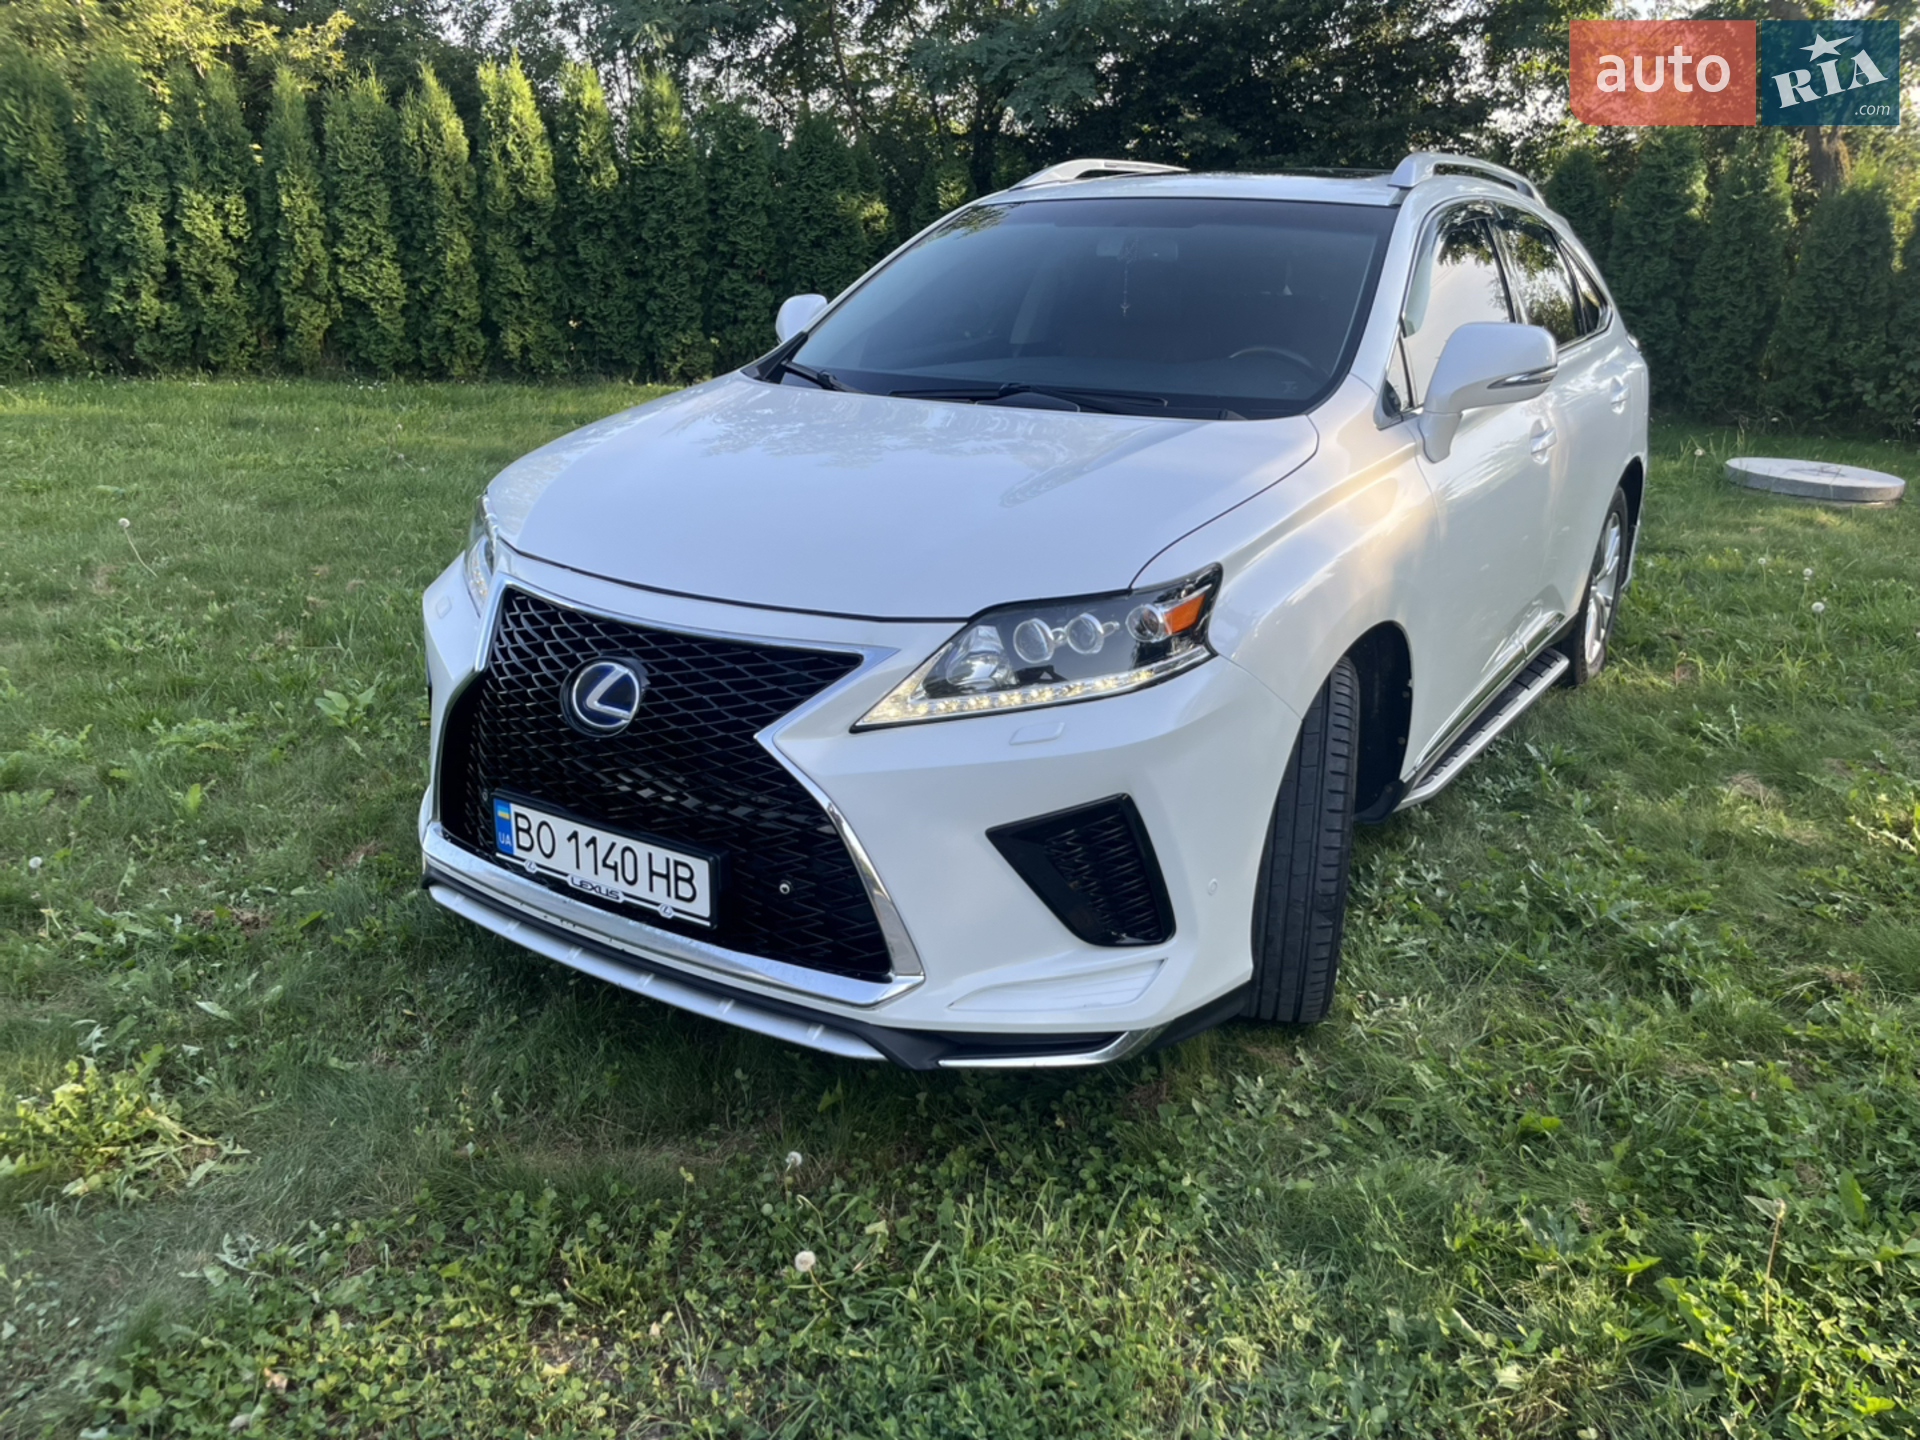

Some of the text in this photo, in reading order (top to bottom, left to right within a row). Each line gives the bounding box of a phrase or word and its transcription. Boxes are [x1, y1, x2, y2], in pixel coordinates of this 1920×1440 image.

[498, 832, 512, 847] UA
[514, 811, 697, 903] BO 1140 HB
[571, 876, 621, 899] LEXUS
